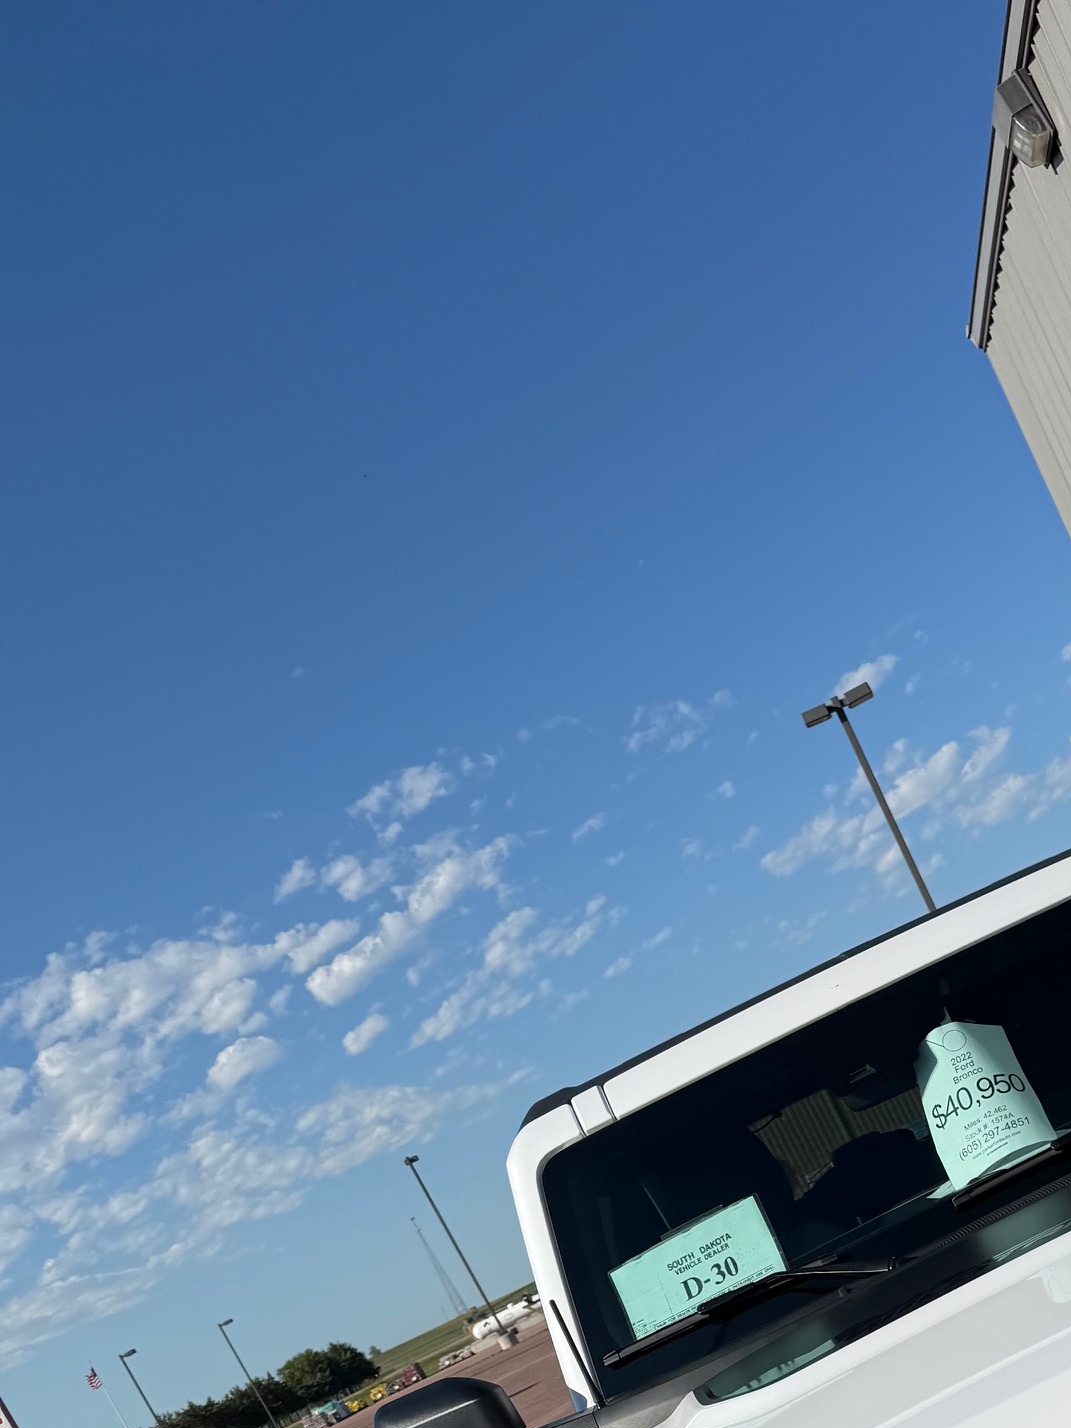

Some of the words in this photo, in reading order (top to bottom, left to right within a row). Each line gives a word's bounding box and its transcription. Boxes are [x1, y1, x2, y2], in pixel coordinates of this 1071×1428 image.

[951, 1051, 973, 1066] 2022
[954, 1060, 975, 1073] Ford
[953, 1066, 983, 1085] Bronco
[932, 1073, 1026, 1130] $40,950
[964, 1117, 982, 1131] Miles:
[984, 1105, 1007, 1119] 42,462
[965, 1128, 982, 1141] Stock
[991, 1112, 1014, 1125] 1574A
[959, 1139, 981, 1161] (605)
[983, 1116, 1030, 1143] 297-4851
[667, 1252, 695, 1272] SOUTH
[699, 1232, 732, 1254] DAKOTA
[674, 1257, 703, 1276] VEHICLE
[703, 1243, 730, 1261] DEALER
[680, 1256, 739, 1302] D-30
